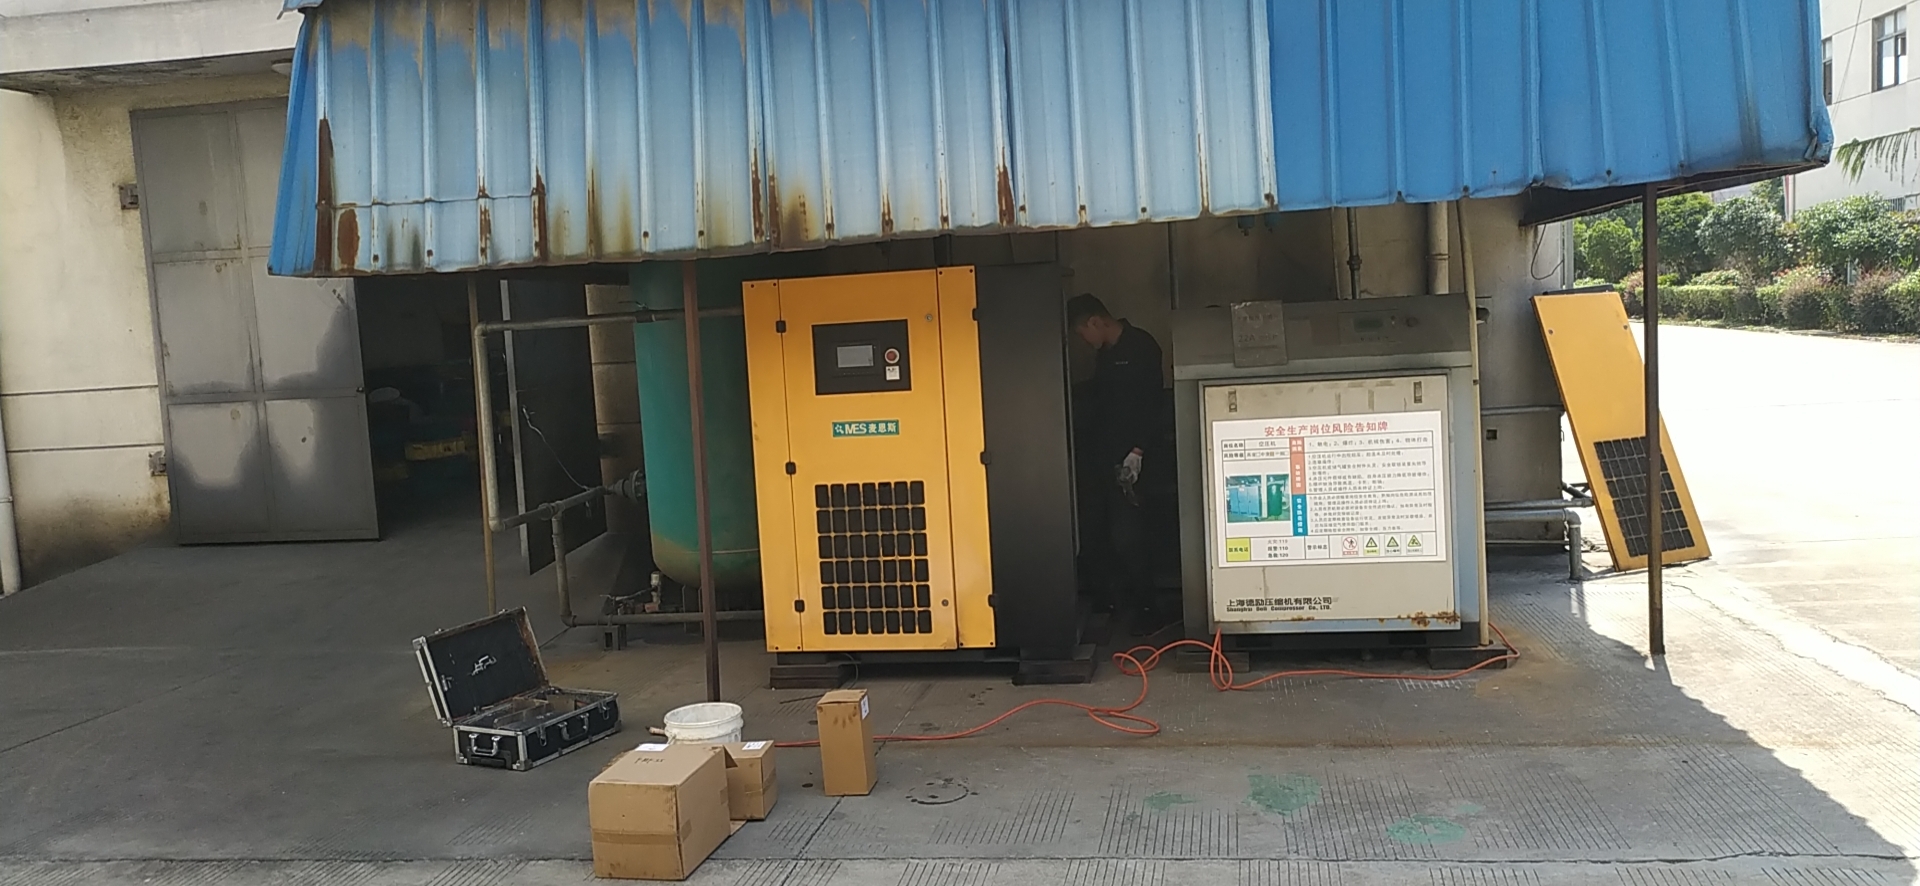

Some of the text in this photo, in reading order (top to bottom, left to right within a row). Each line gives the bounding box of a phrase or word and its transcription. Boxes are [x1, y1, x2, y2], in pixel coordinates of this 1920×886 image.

[845, 423, 867, 435] MES
[1264, 422, 1389, 437] 安全生产岗位风险告知牌
[1226, 597, 1332, 606] 上海德励压缩机有限公司
